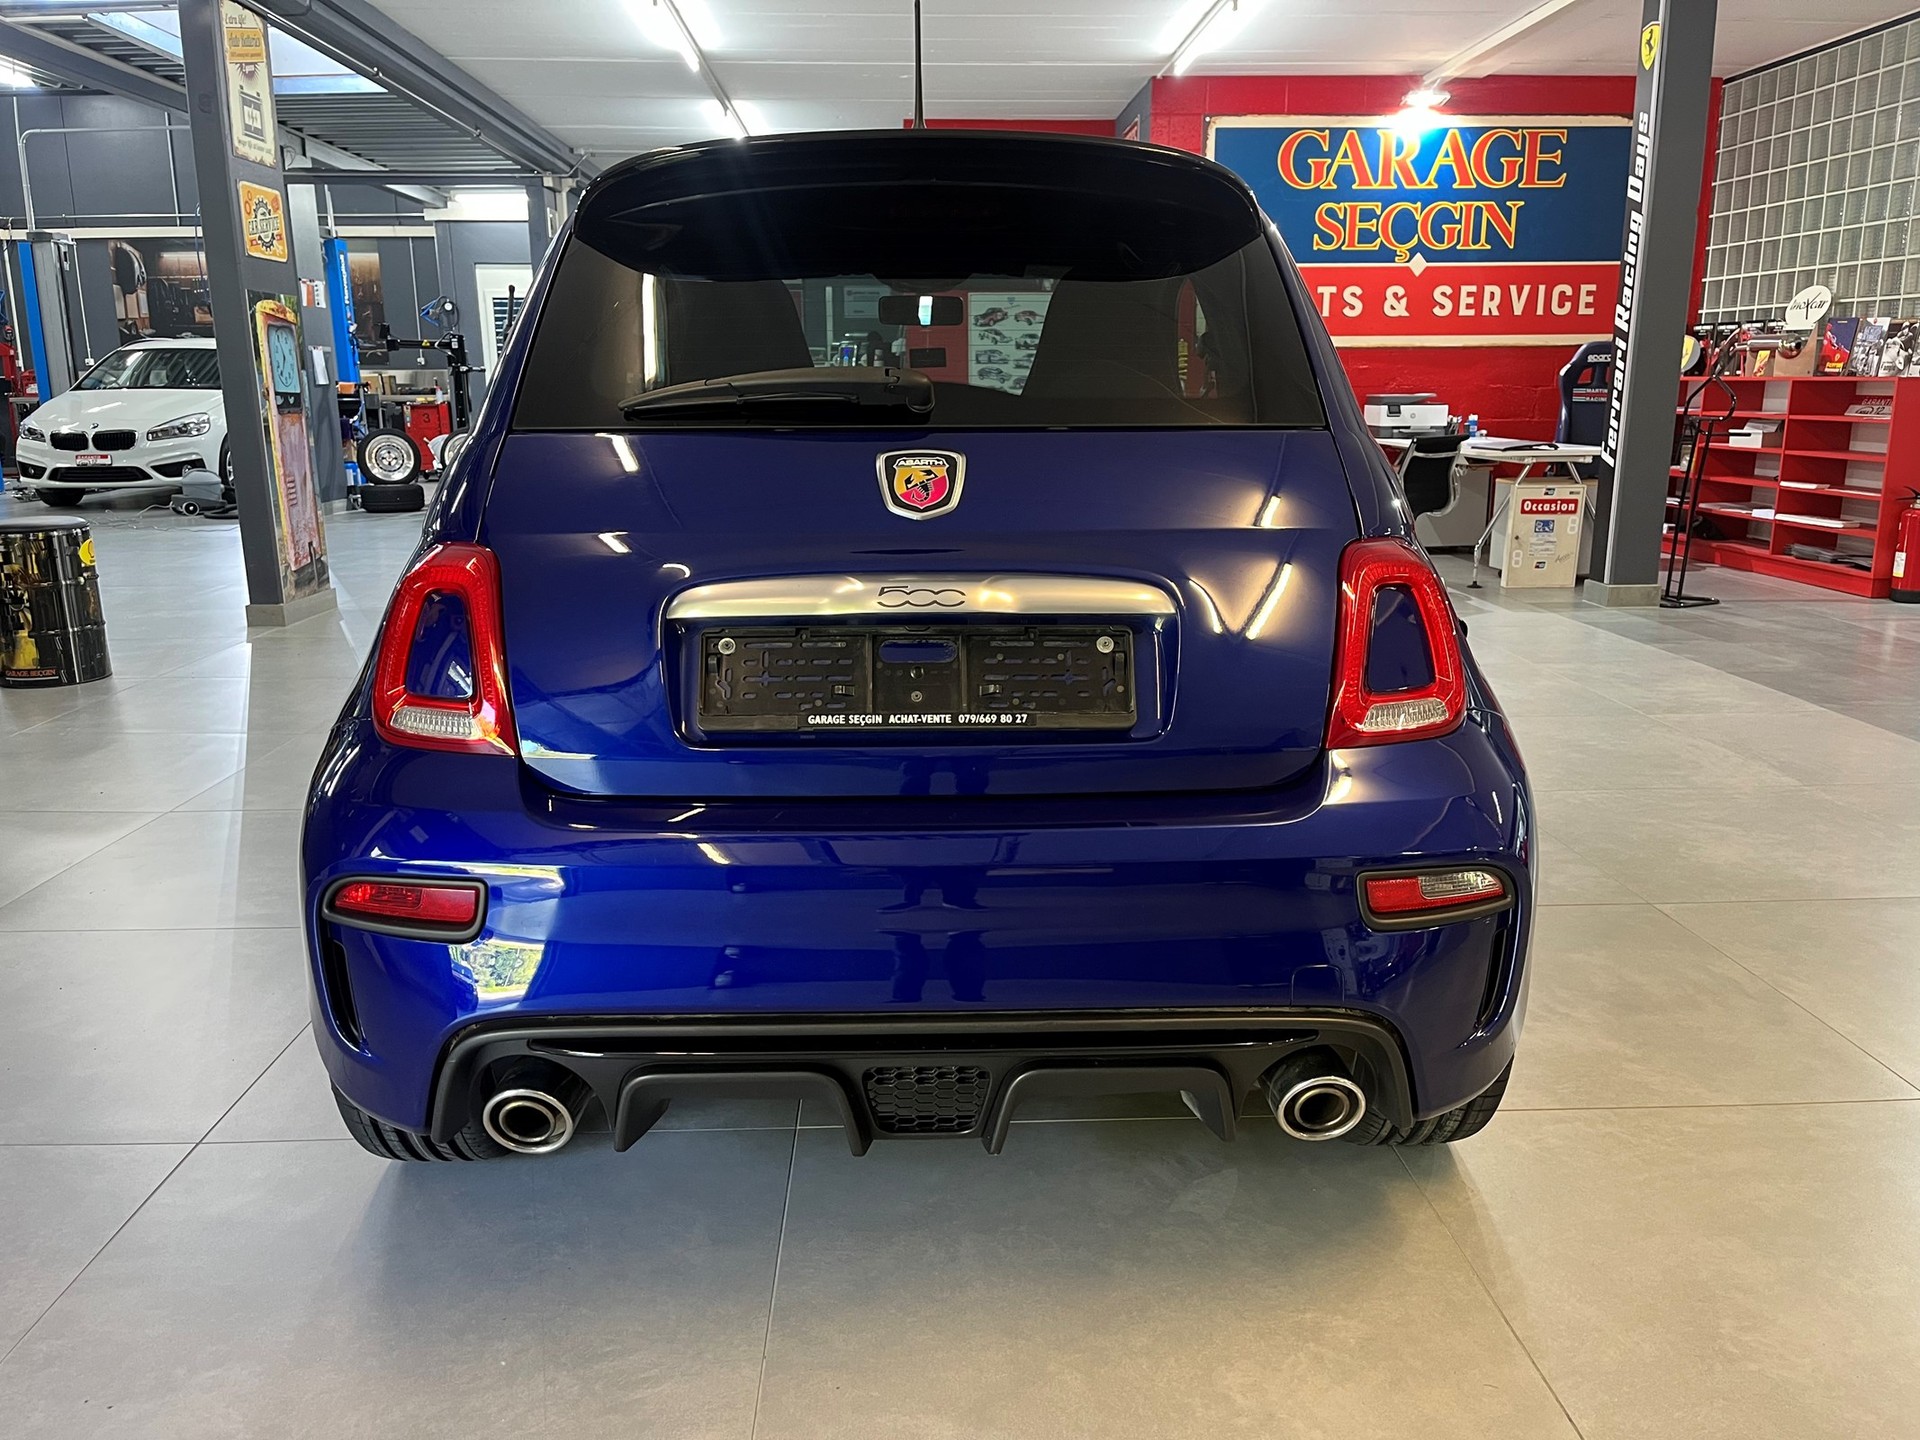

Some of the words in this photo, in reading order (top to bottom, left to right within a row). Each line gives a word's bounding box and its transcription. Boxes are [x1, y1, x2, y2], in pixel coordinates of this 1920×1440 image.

[1277, 128, 1569, 190] GARAGE
[1627, 111, 1650, 204] Days
[1312, 200, 1526, 263] SEÇGIN
[1614, 209, 1644, 334] Racing
[1382, 285, 1411, 317] &
[1431, 284, 1598, 317] SERVICE
[1587, 354, 1612, 363] sparc
[422, 412, 431, 423] 3
[1600, 336, 1627, 469] Ferrari
[1523, 500, 1576, 512] Occasion
[876, 585, 967, 608] 500
[807, 715, 846, 725] GARAGE
[848, 715, 883, 726] SEÇGIN
[888, 714, 952, 724] ACHAT-VENTE
[958, 714, 997, 724] 079/669
[1000, 714, 1013, 724] 80
[1015, 714, 1028, 724] 27
